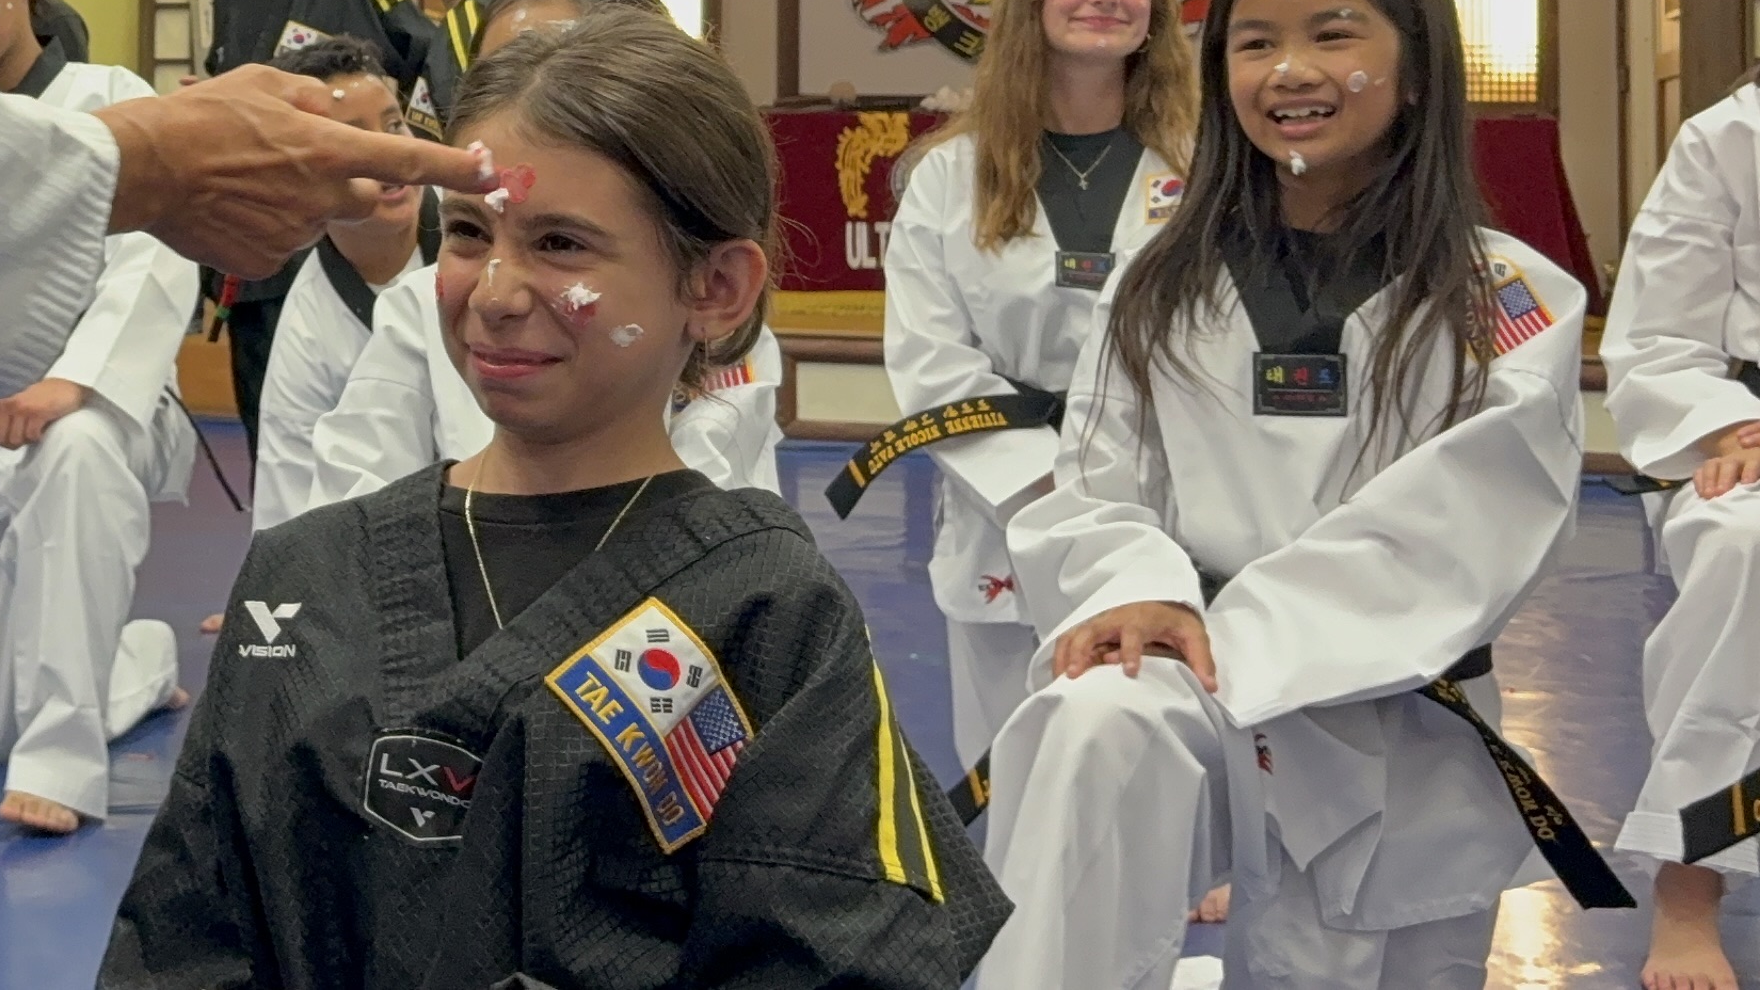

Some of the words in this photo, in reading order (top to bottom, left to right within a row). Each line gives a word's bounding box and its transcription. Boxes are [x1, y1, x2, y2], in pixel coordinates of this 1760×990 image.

[894, 424, 942, 453] NICOLE
[238, 643, 297, 658] VISION
[575, 671, 625, 725] TAE
[615, 722, 669, 795] KWON
[657, 791, 685, 827] DO
[380, 752, 477, 793] LXV
